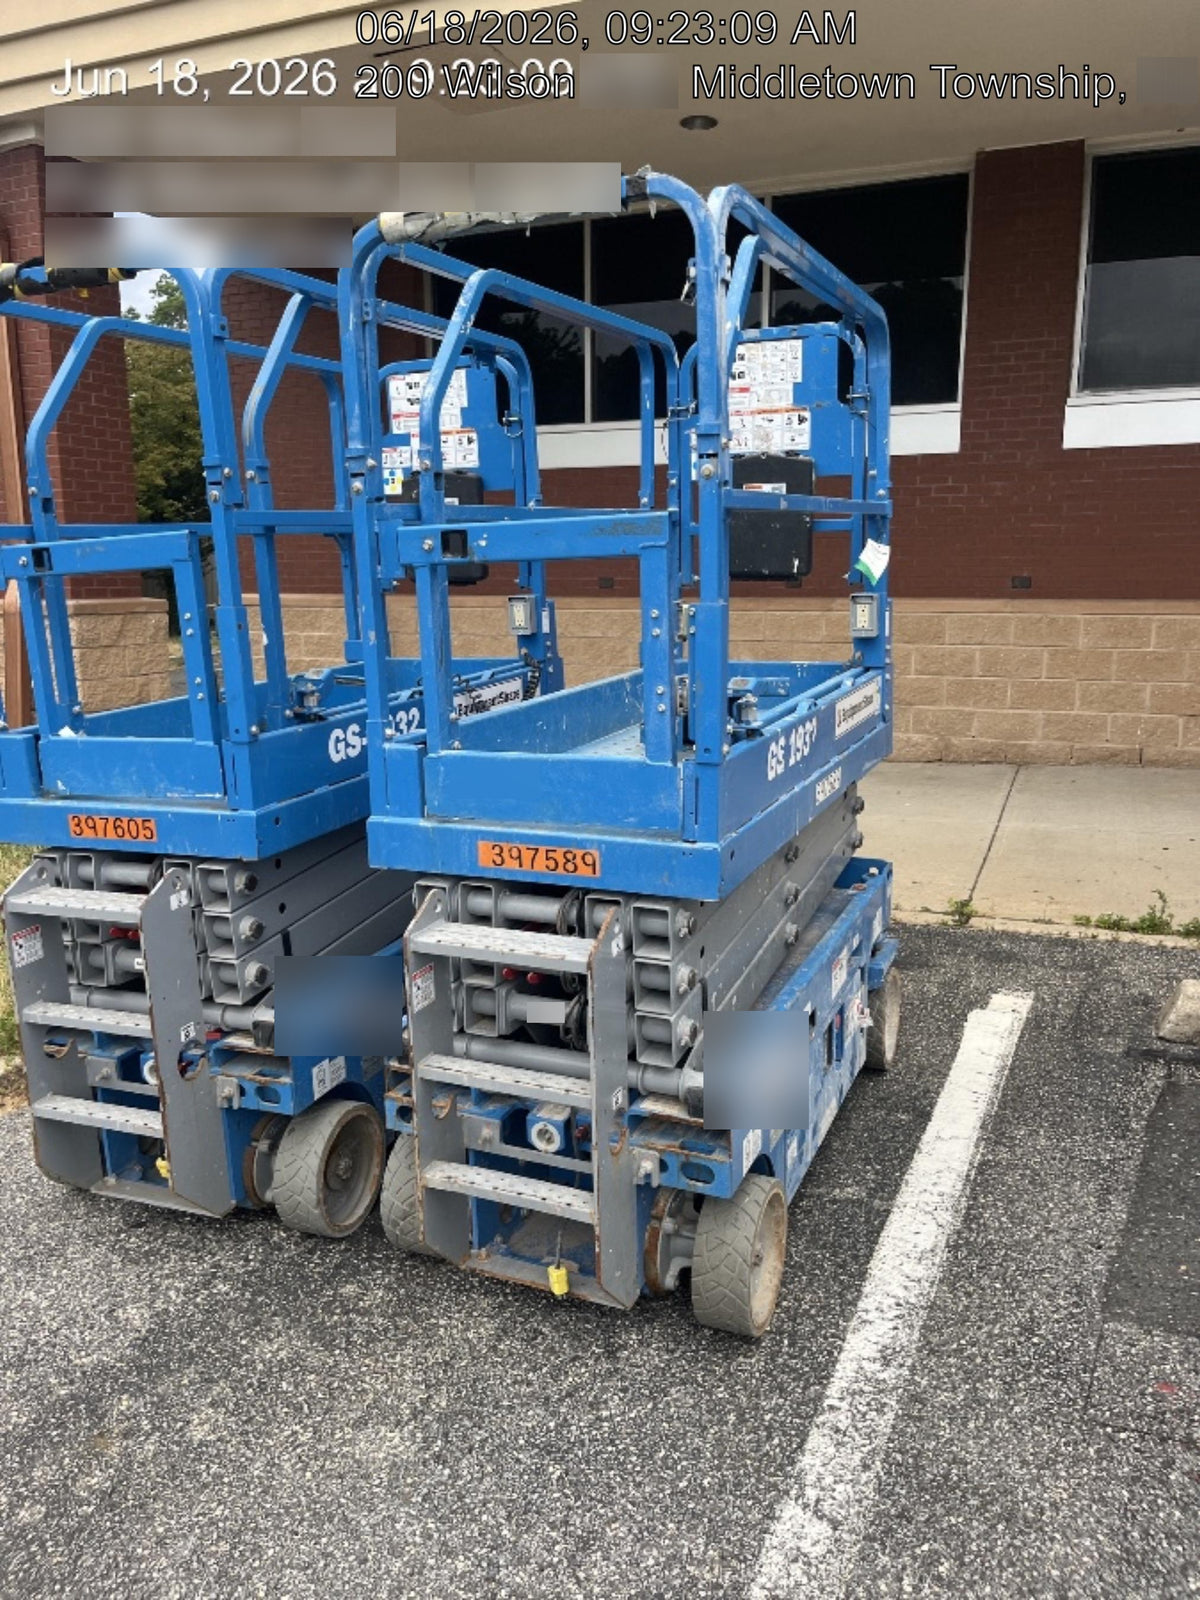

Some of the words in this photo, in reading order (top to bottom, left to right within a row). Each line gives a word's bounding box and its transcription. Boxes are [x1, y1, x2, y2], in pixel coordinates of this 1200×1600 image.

[328, 706, 421, 764] GS-32
[71, 815, 155, 840] 397605
[491, 843, 597, 876] 397589
